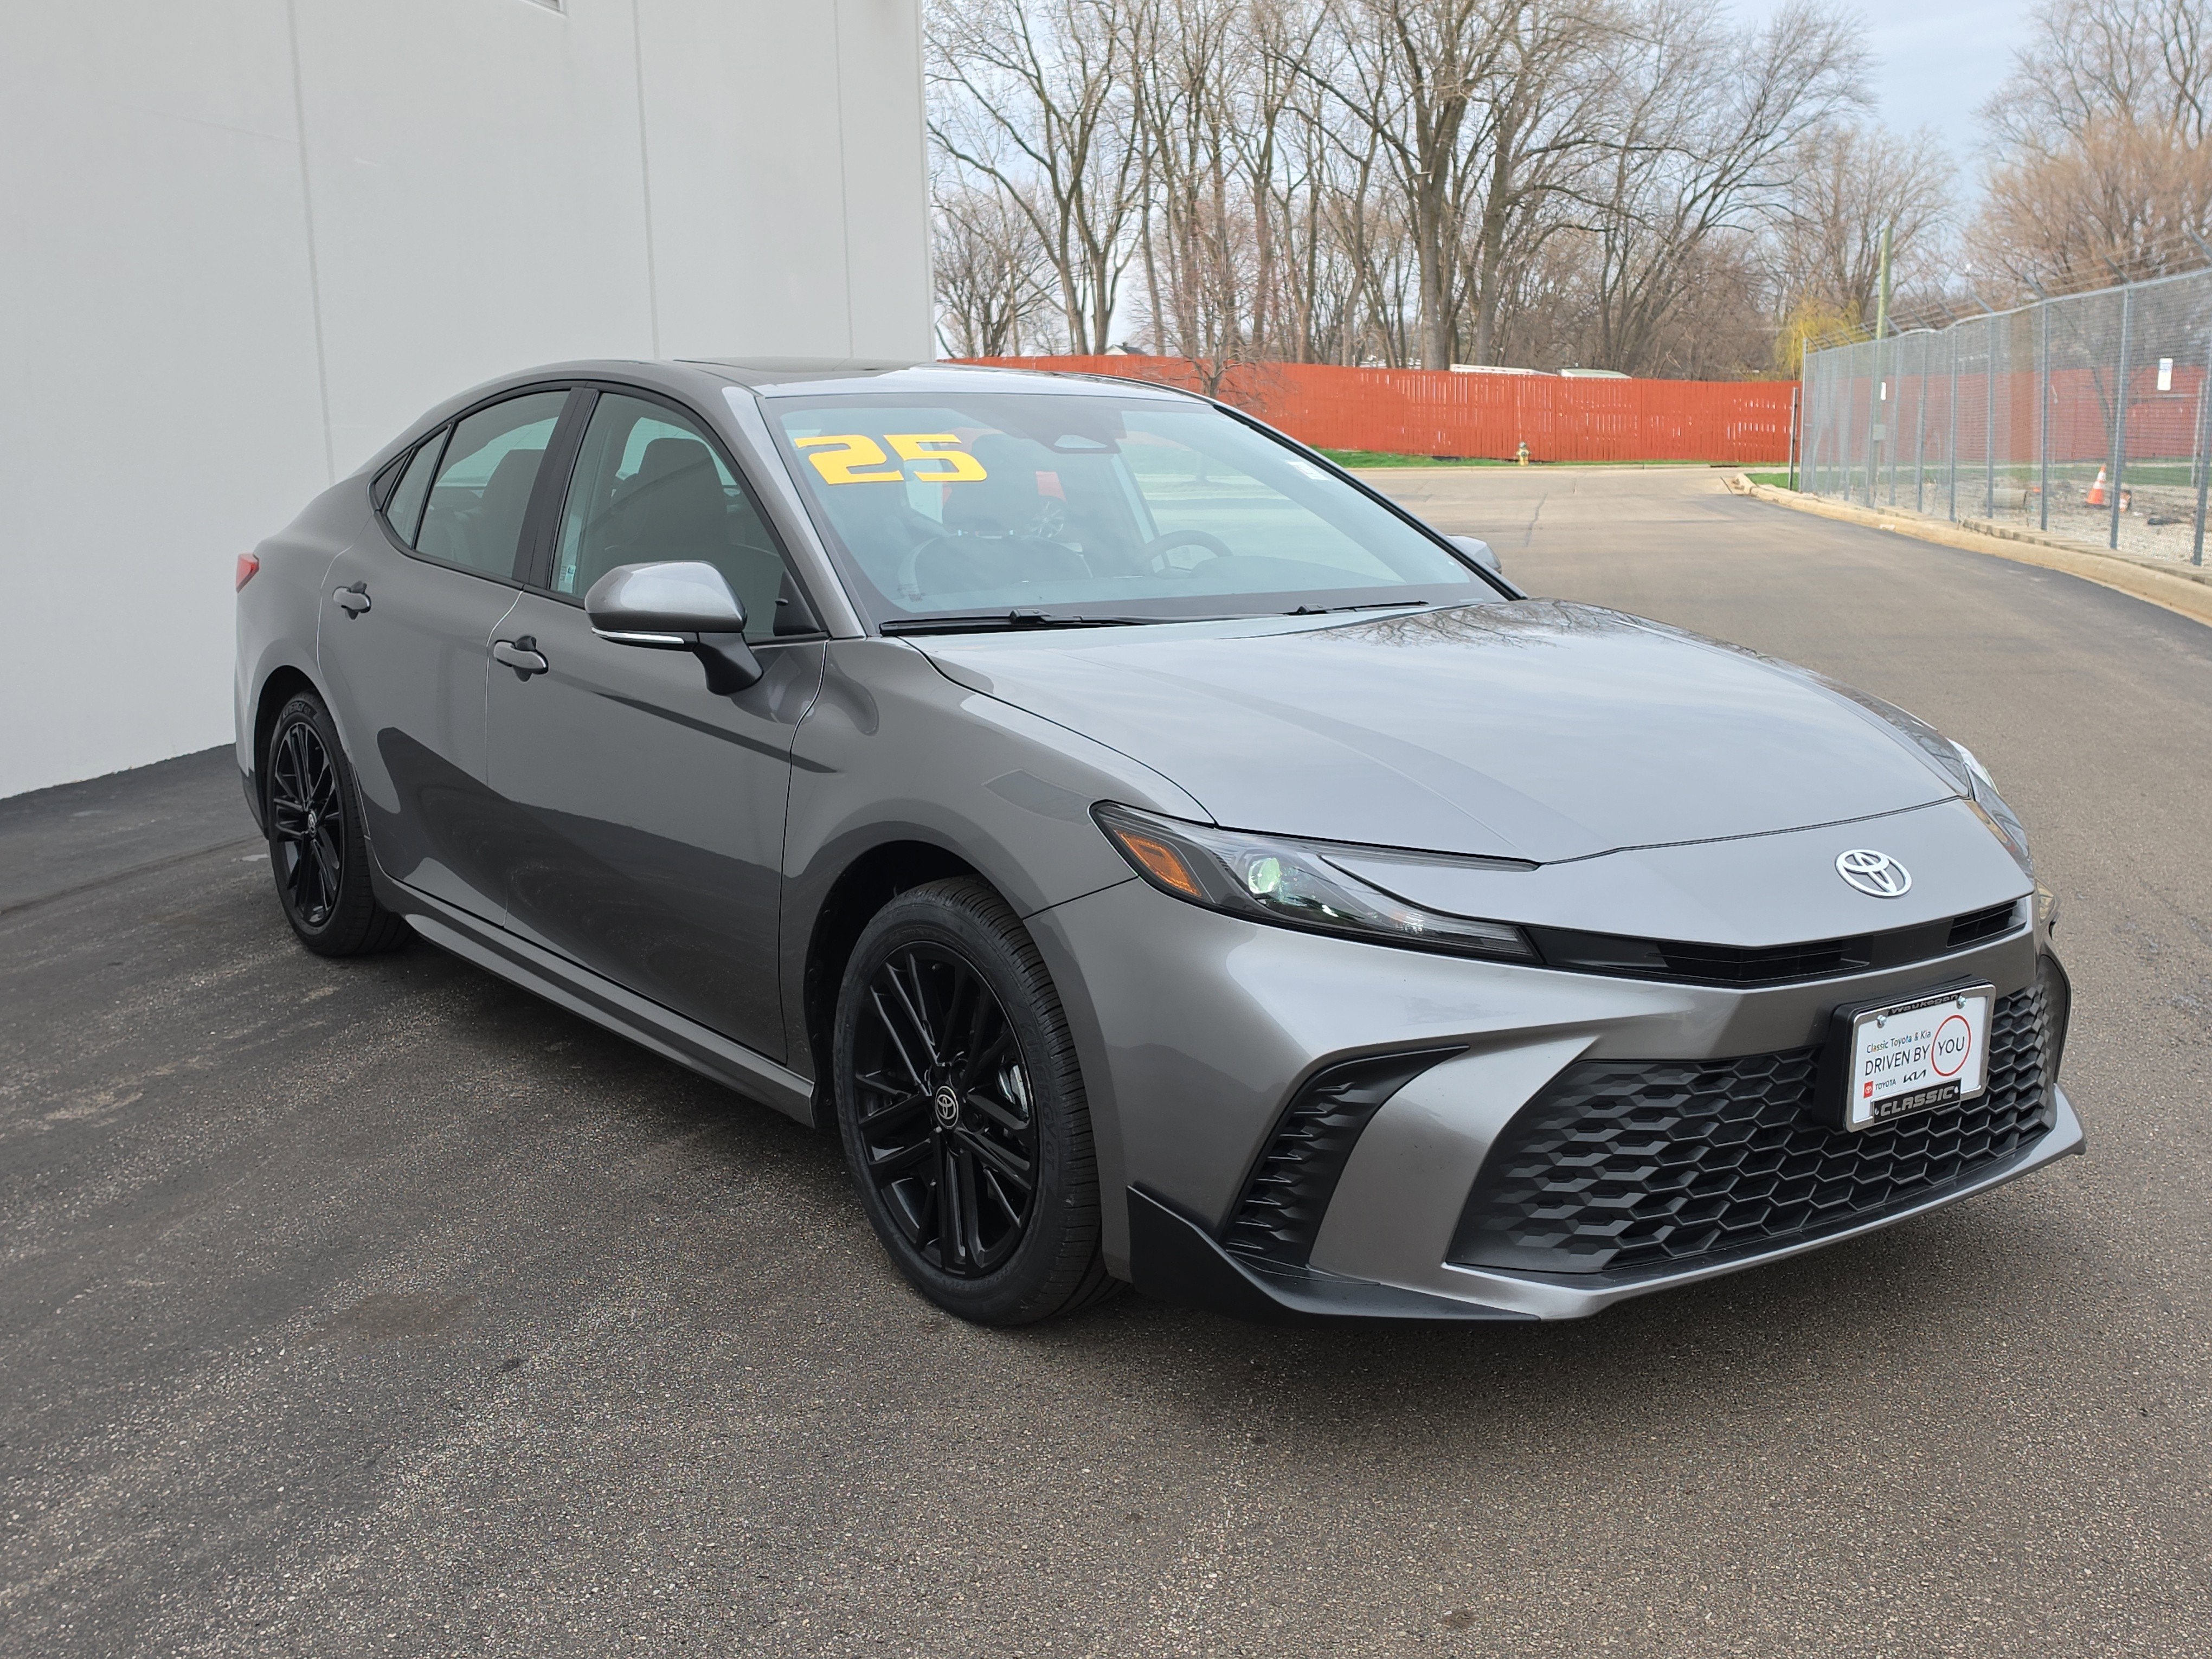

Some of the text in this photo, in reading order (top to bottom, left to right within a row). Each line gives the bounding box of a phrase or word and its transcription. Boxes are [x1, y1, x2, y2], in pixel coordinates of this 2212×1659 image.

[794, 434, 988, 485] 25
[1891, 994, 1958, 1014] Waukegan
[1867, 1030, 1931, 1053] Classic Toyota & Kia
[1865, 1036, 1965, 1076] DRIVEN BY YOU
[1875, 1079, 1896, 1091] TOYOTA
[1880, 1086, 1954, 1116] CLASSIC
